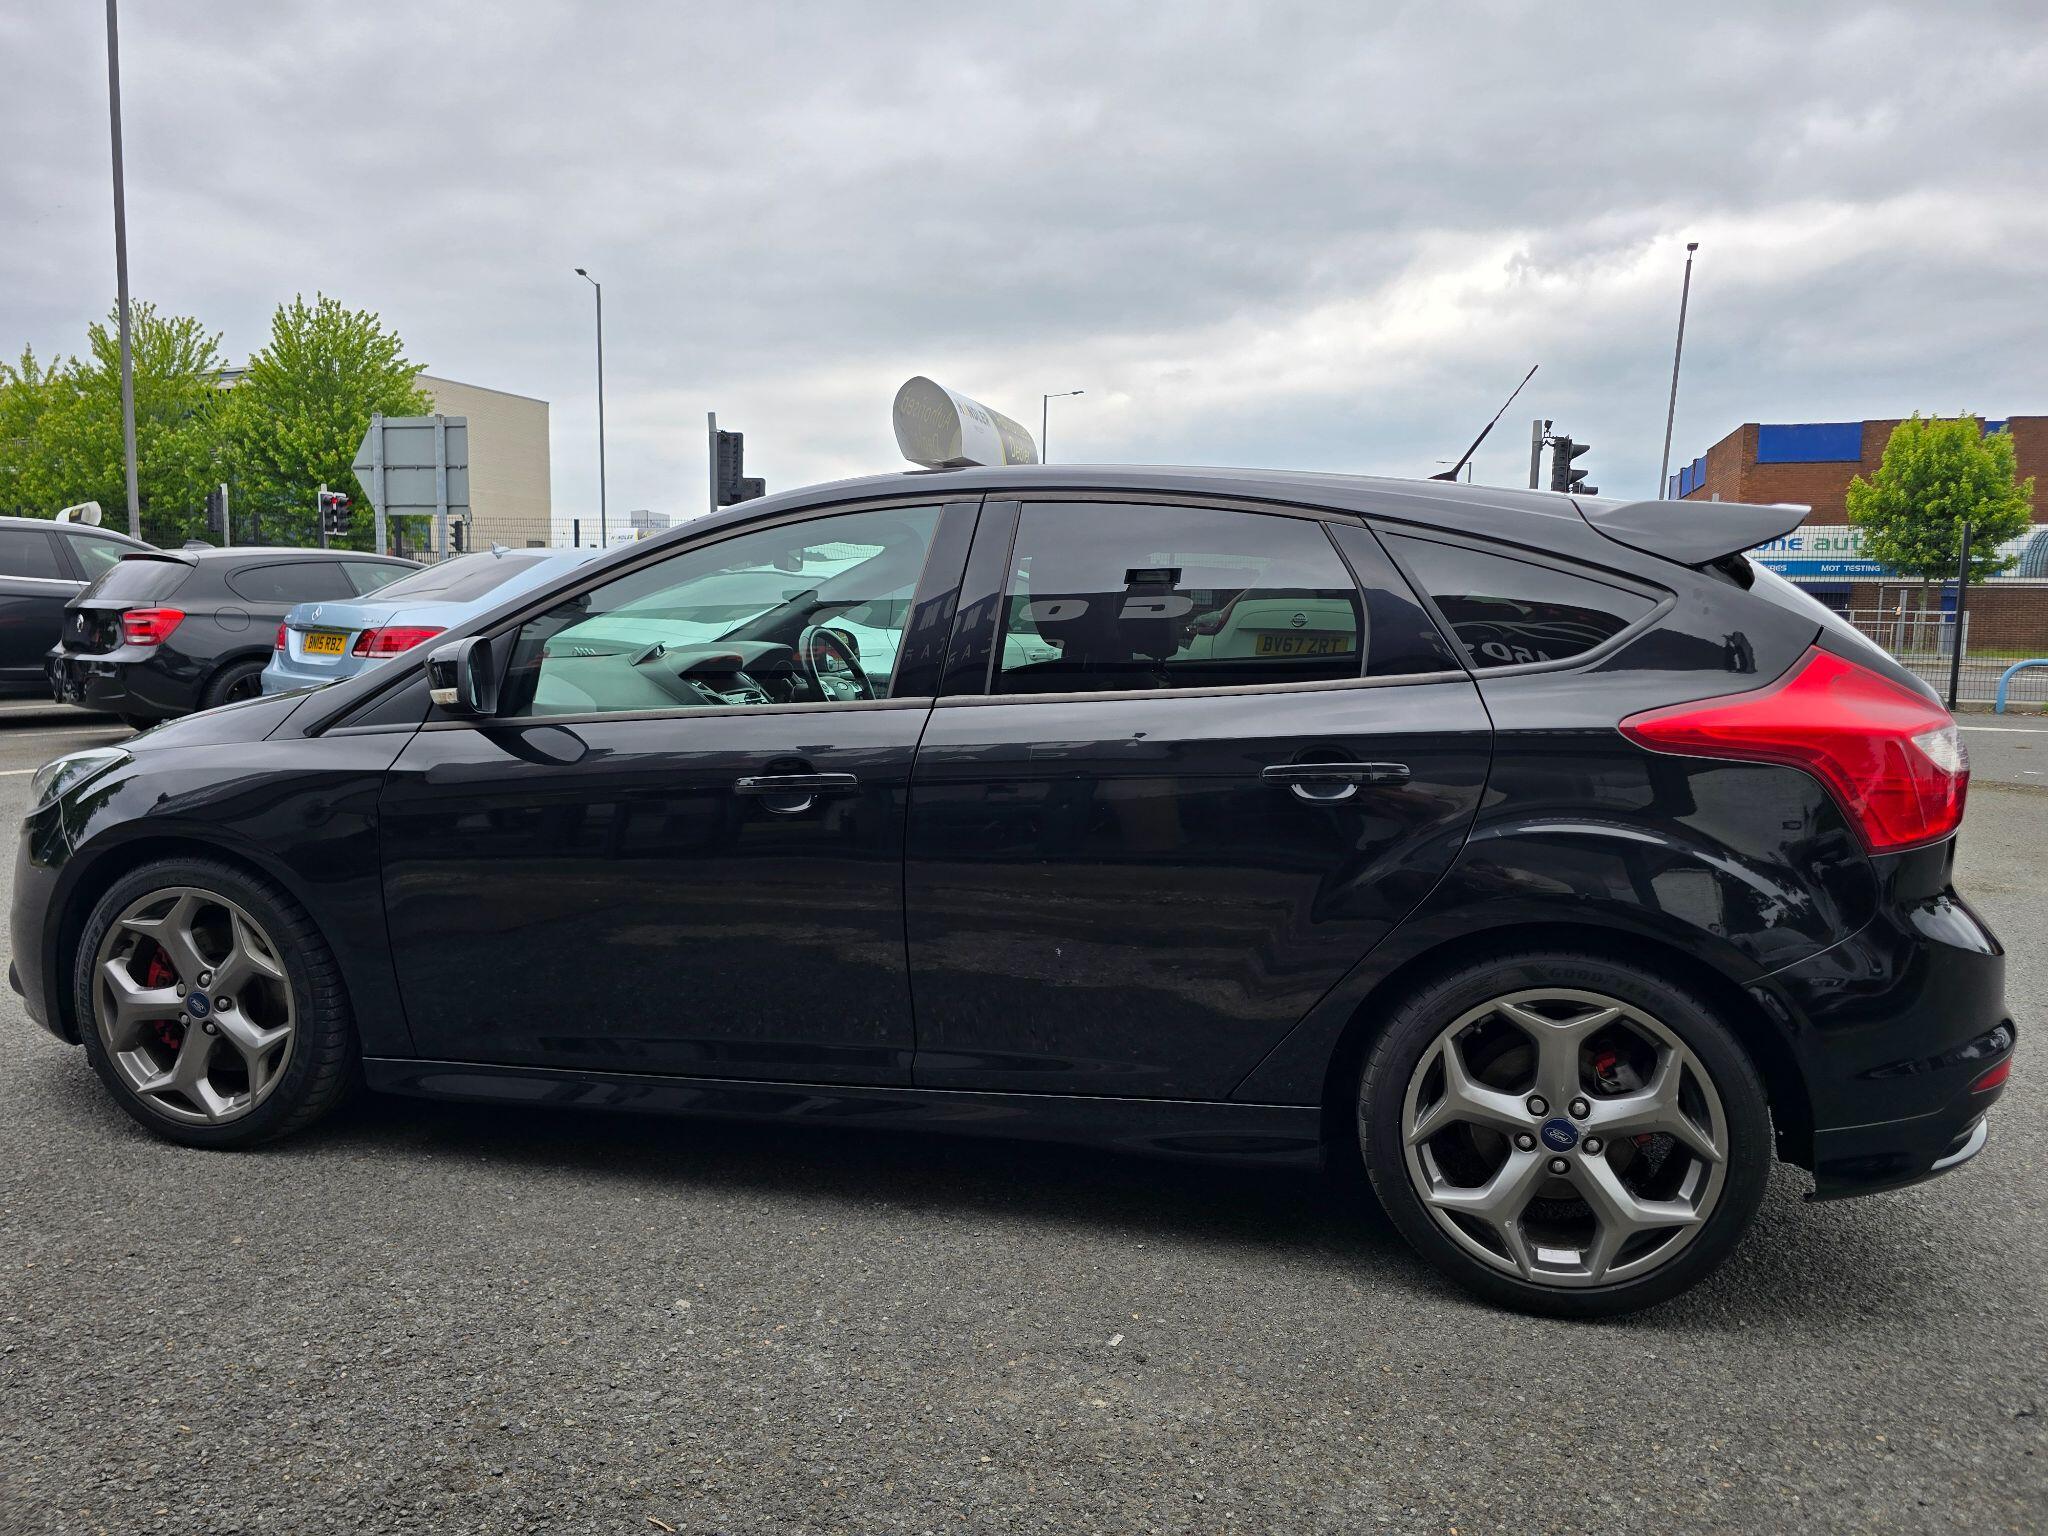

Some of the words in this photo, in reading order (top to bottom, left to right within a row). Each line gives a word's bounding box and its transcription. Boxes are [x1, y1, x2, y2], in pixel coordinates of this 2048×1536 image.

[1821, 564, 1840, 572] MOT
[1844, 564, 1880, 572] TESTING
[324, 637, 343, 652] RBZ
[1262, 636, 1305, 653] BV67
[1307, 638, 1343, 654] ZRT
